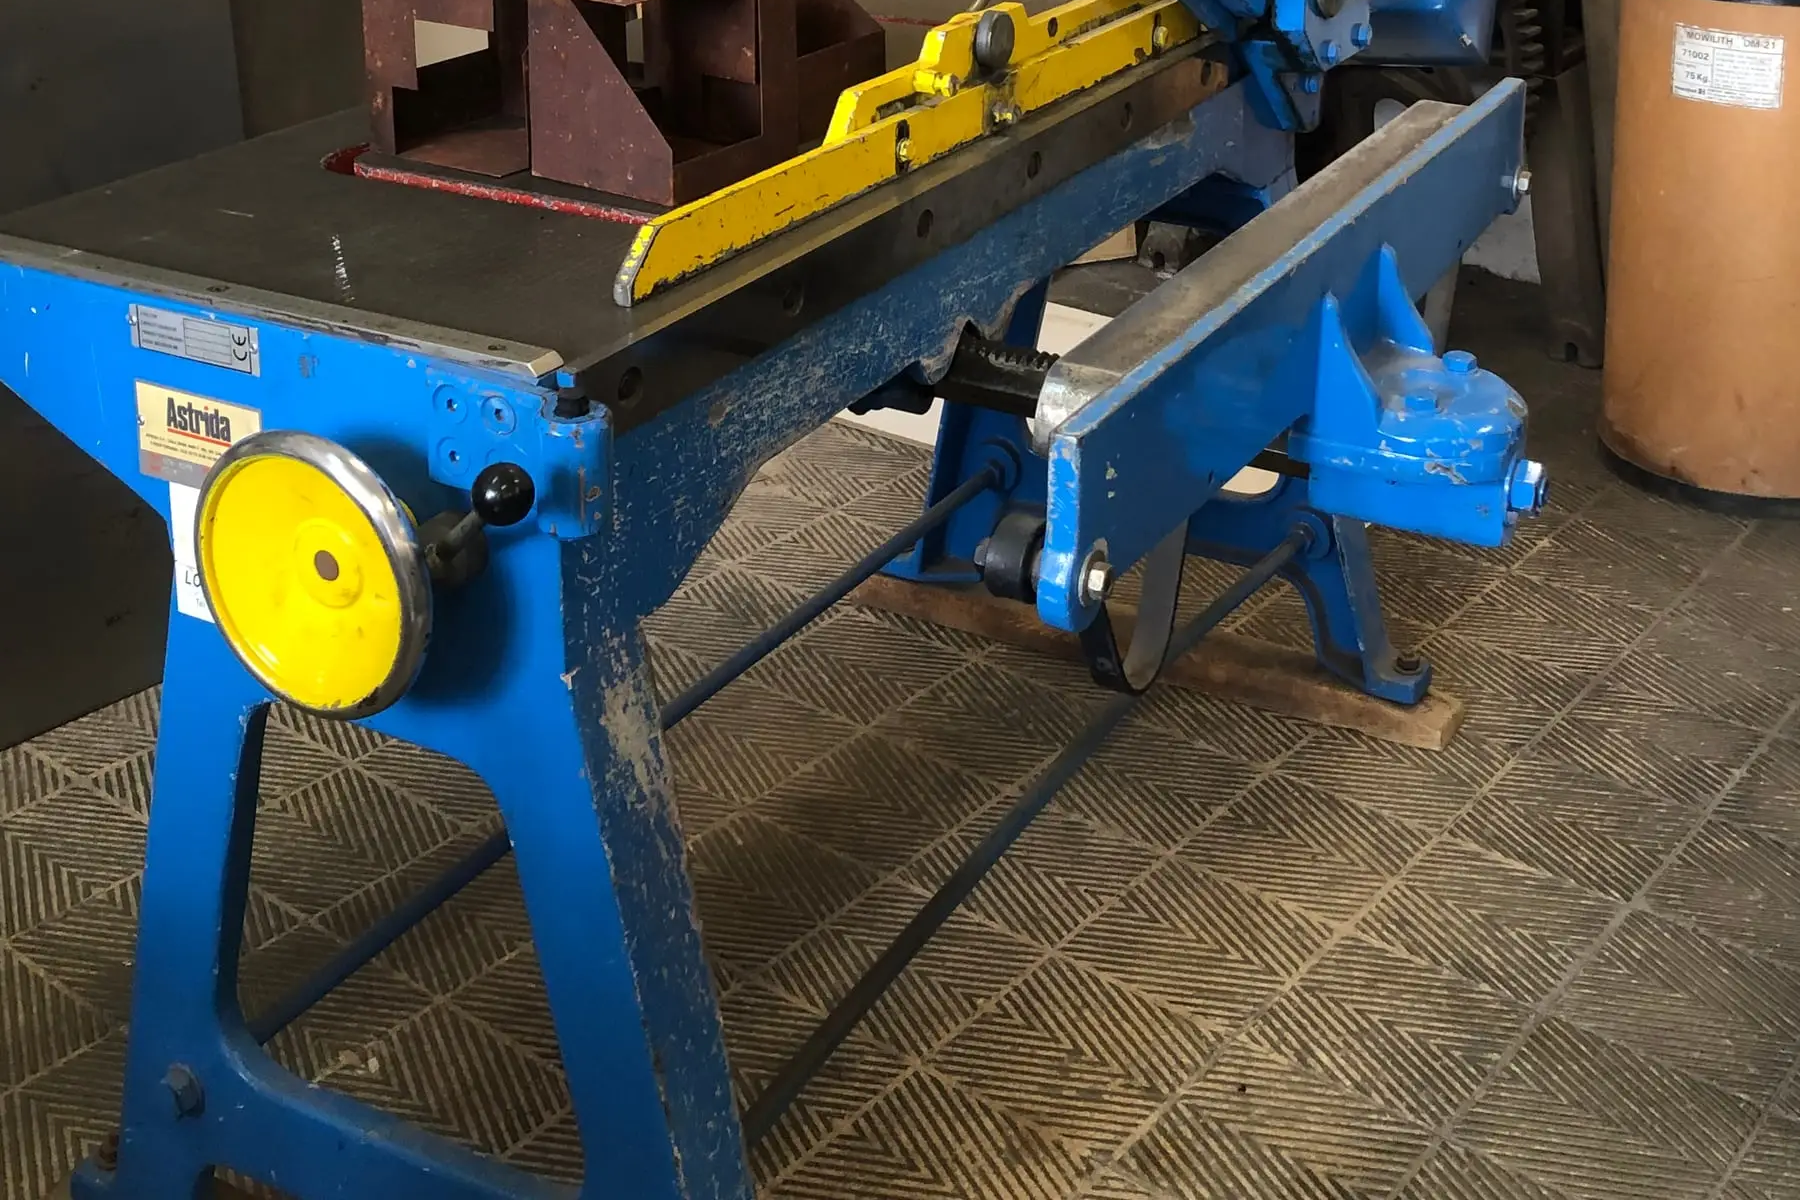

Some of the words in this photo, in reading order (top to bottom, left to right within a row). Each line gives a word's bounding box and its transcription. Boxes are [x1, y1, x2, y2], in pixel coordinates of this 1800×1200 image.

[1686, 31, 1733, 46] MOWILITH
[1743, 38, 1776, 50] DM-21
[1682, 49, 1710, 61] 71002
[231, 332, 248, 362] CE
[166, 396, 232, 443] Astrida
